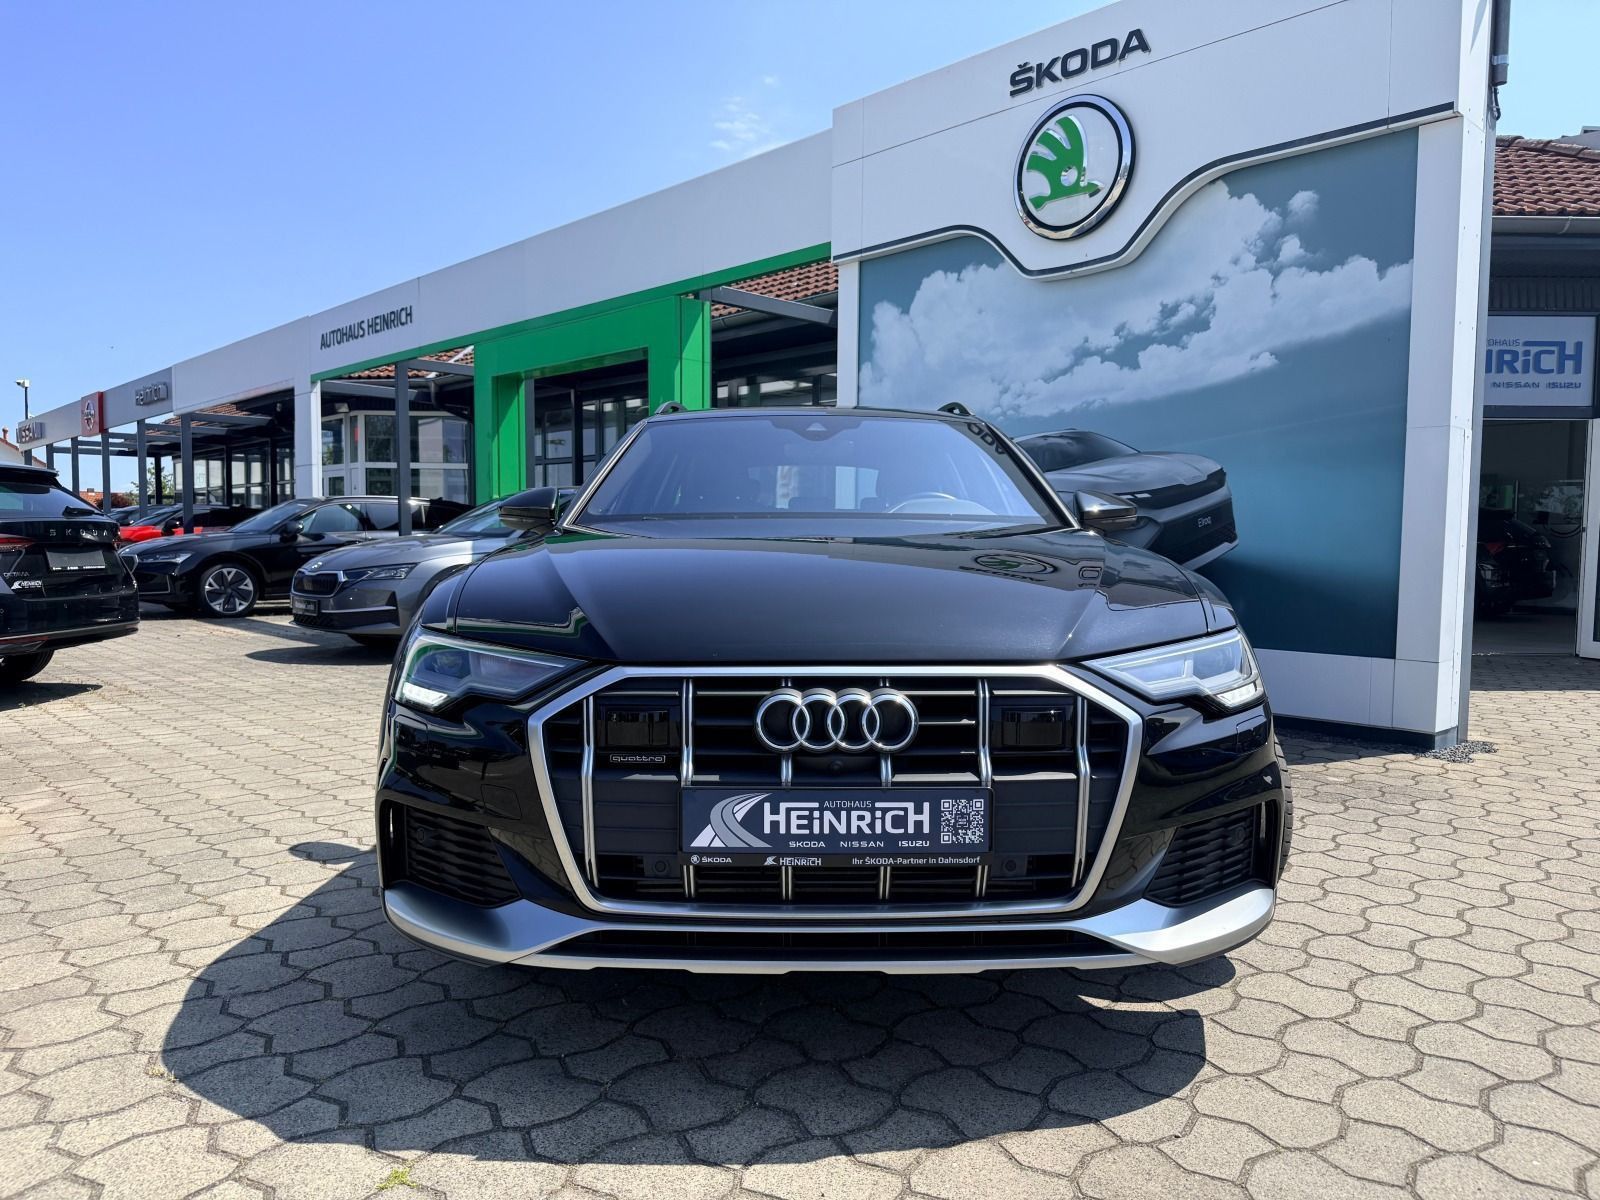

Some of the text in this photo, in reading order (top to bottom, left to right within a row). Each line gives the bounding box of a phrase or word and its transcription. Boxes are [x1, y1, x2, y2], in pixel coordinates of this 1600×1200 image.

[1009, 28, 1151, 97] ŠKODA
[320, 305, 413, 350] AUTOHAUS HEINRICH
[1491, 381, 1582, 389] NISSAN ISUZU
[823, 800, 872, 808] AUTOHAUS
[839, 840, 884, 848] NISSAN
[852, 857, 864, 865] Ihr
[865, 856, 927, 865] ŠKODA-Partner
[938, 855, 980, 864] Dahnsdorf
